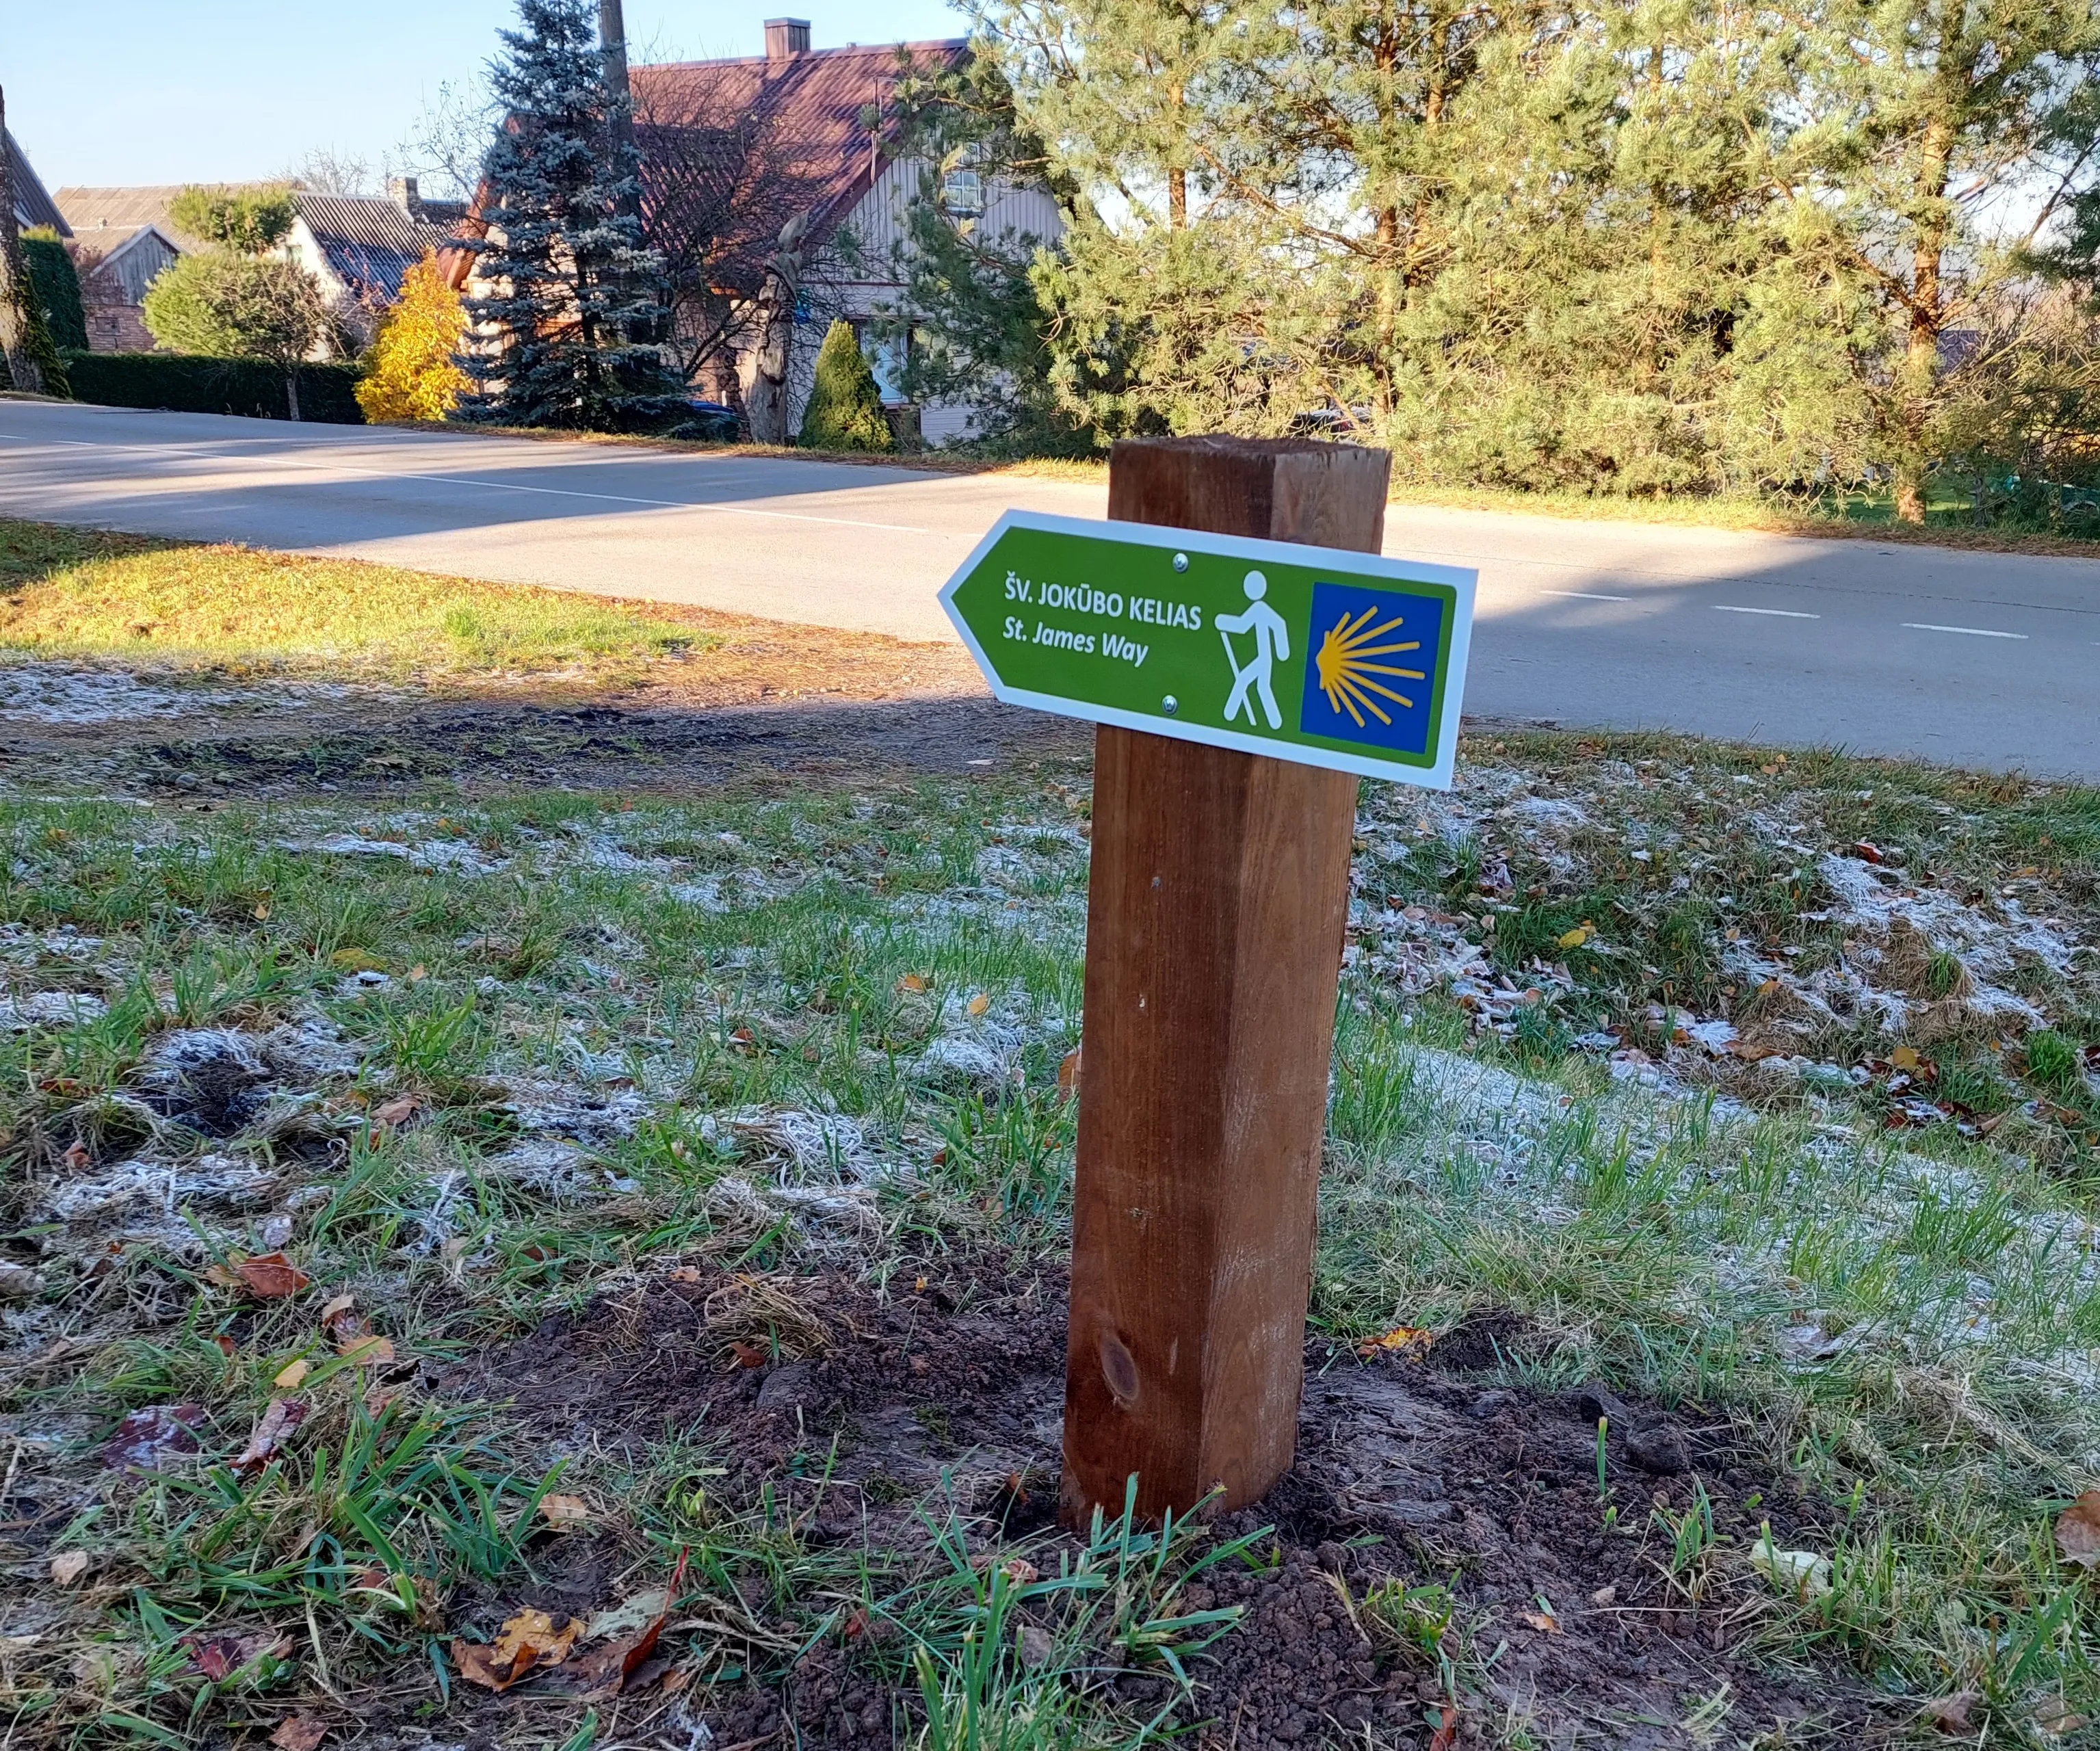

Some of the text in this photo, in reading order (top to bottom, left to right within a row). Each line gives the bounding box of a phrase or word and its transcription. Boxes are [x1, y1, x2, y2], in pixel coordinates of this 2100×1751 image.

[1004, 570, 1202, 631] ŠV. JOKŪBO KELIAS
[1002, 616, 1149, 668] St. James Way
